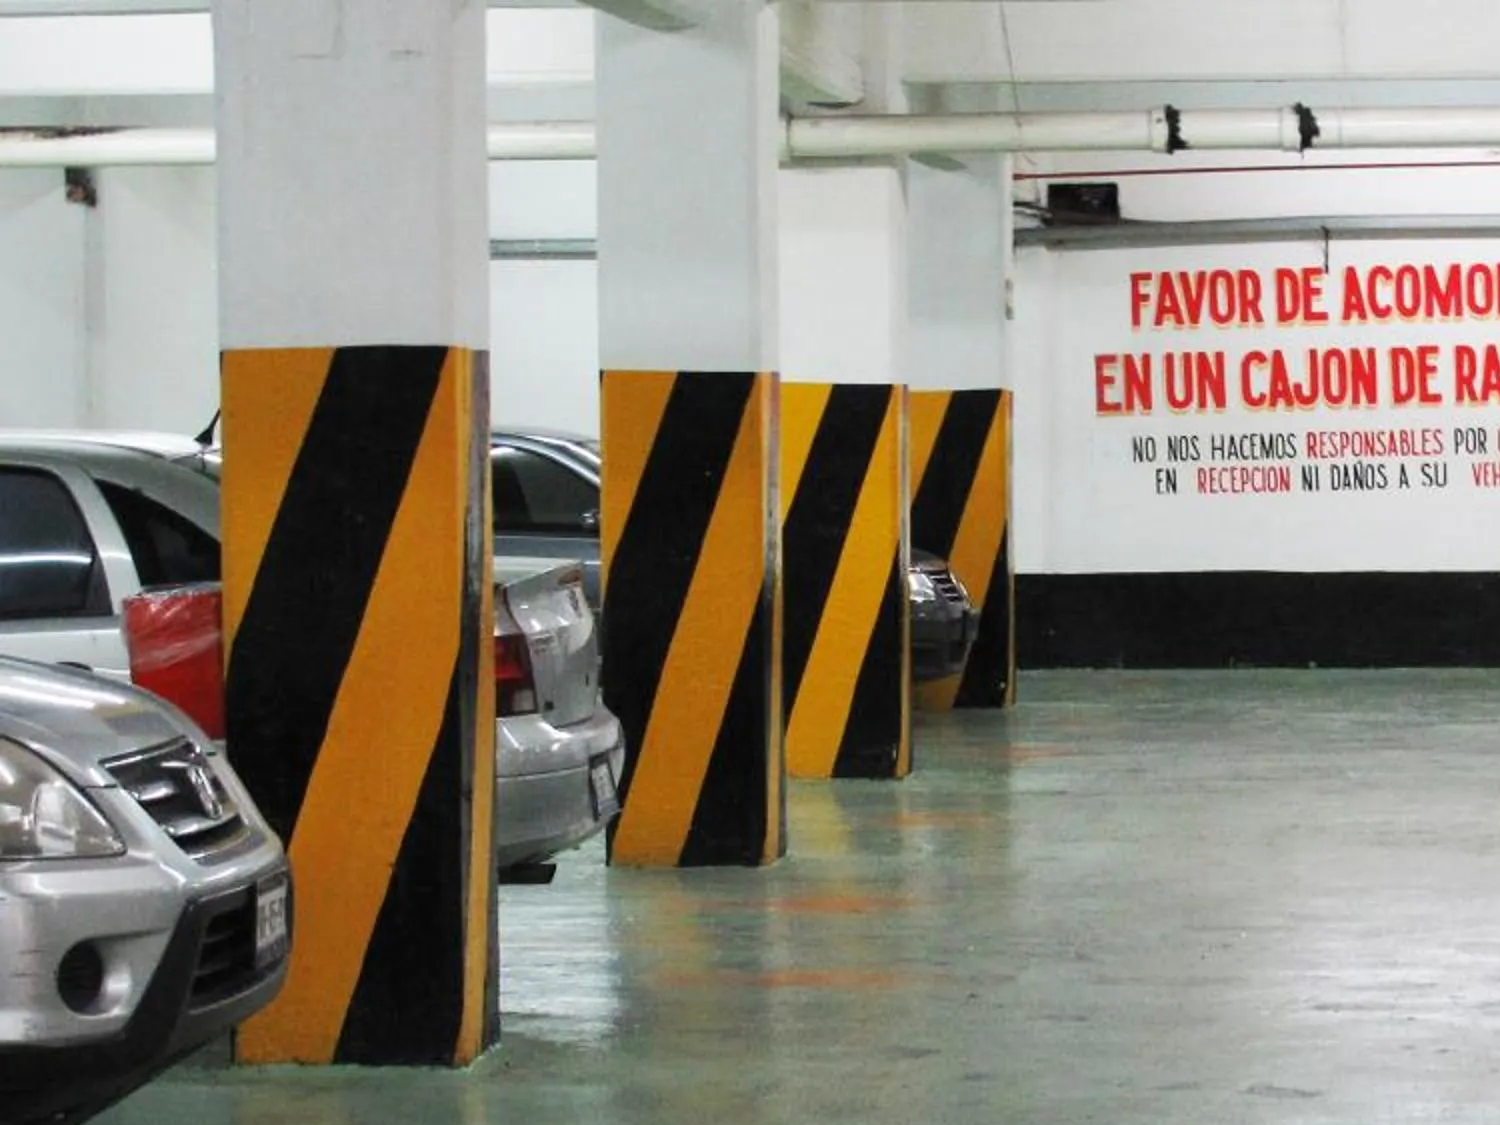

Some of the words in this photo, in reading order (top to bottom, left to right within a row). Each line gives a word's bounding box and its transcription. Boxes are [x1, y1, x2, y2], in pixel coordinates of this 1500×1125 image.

[1130, 270, 1264, 328] FAVOR
[1276, 268, 1329, 324] DE
[1094, 354, 1153, 413] EN
[1164, 352, 1227, 410] UN
[1241, 348, 1378, 408] CAJON
[1390, 346, 1443, 405] DE
[1132, 437, 1156, 463] NO
[1167, 435, 1200, 462] NOS
[1210, 433, 1297, 461] HACEMOS
[1306, 428, 1443, 459] RESPONSABLES
[1453, 427, 1488, 455] POR
[1155, 467, 1178, 495] EN
[1196, 465, 1291, 494] RECEPCION
[1301, 464, 1320, 492] NI
[1330, 459, 1388, 490] DAÑOS
[1398, 463, 1411, 489] A
[1420, 462, 1447, 488] SU
